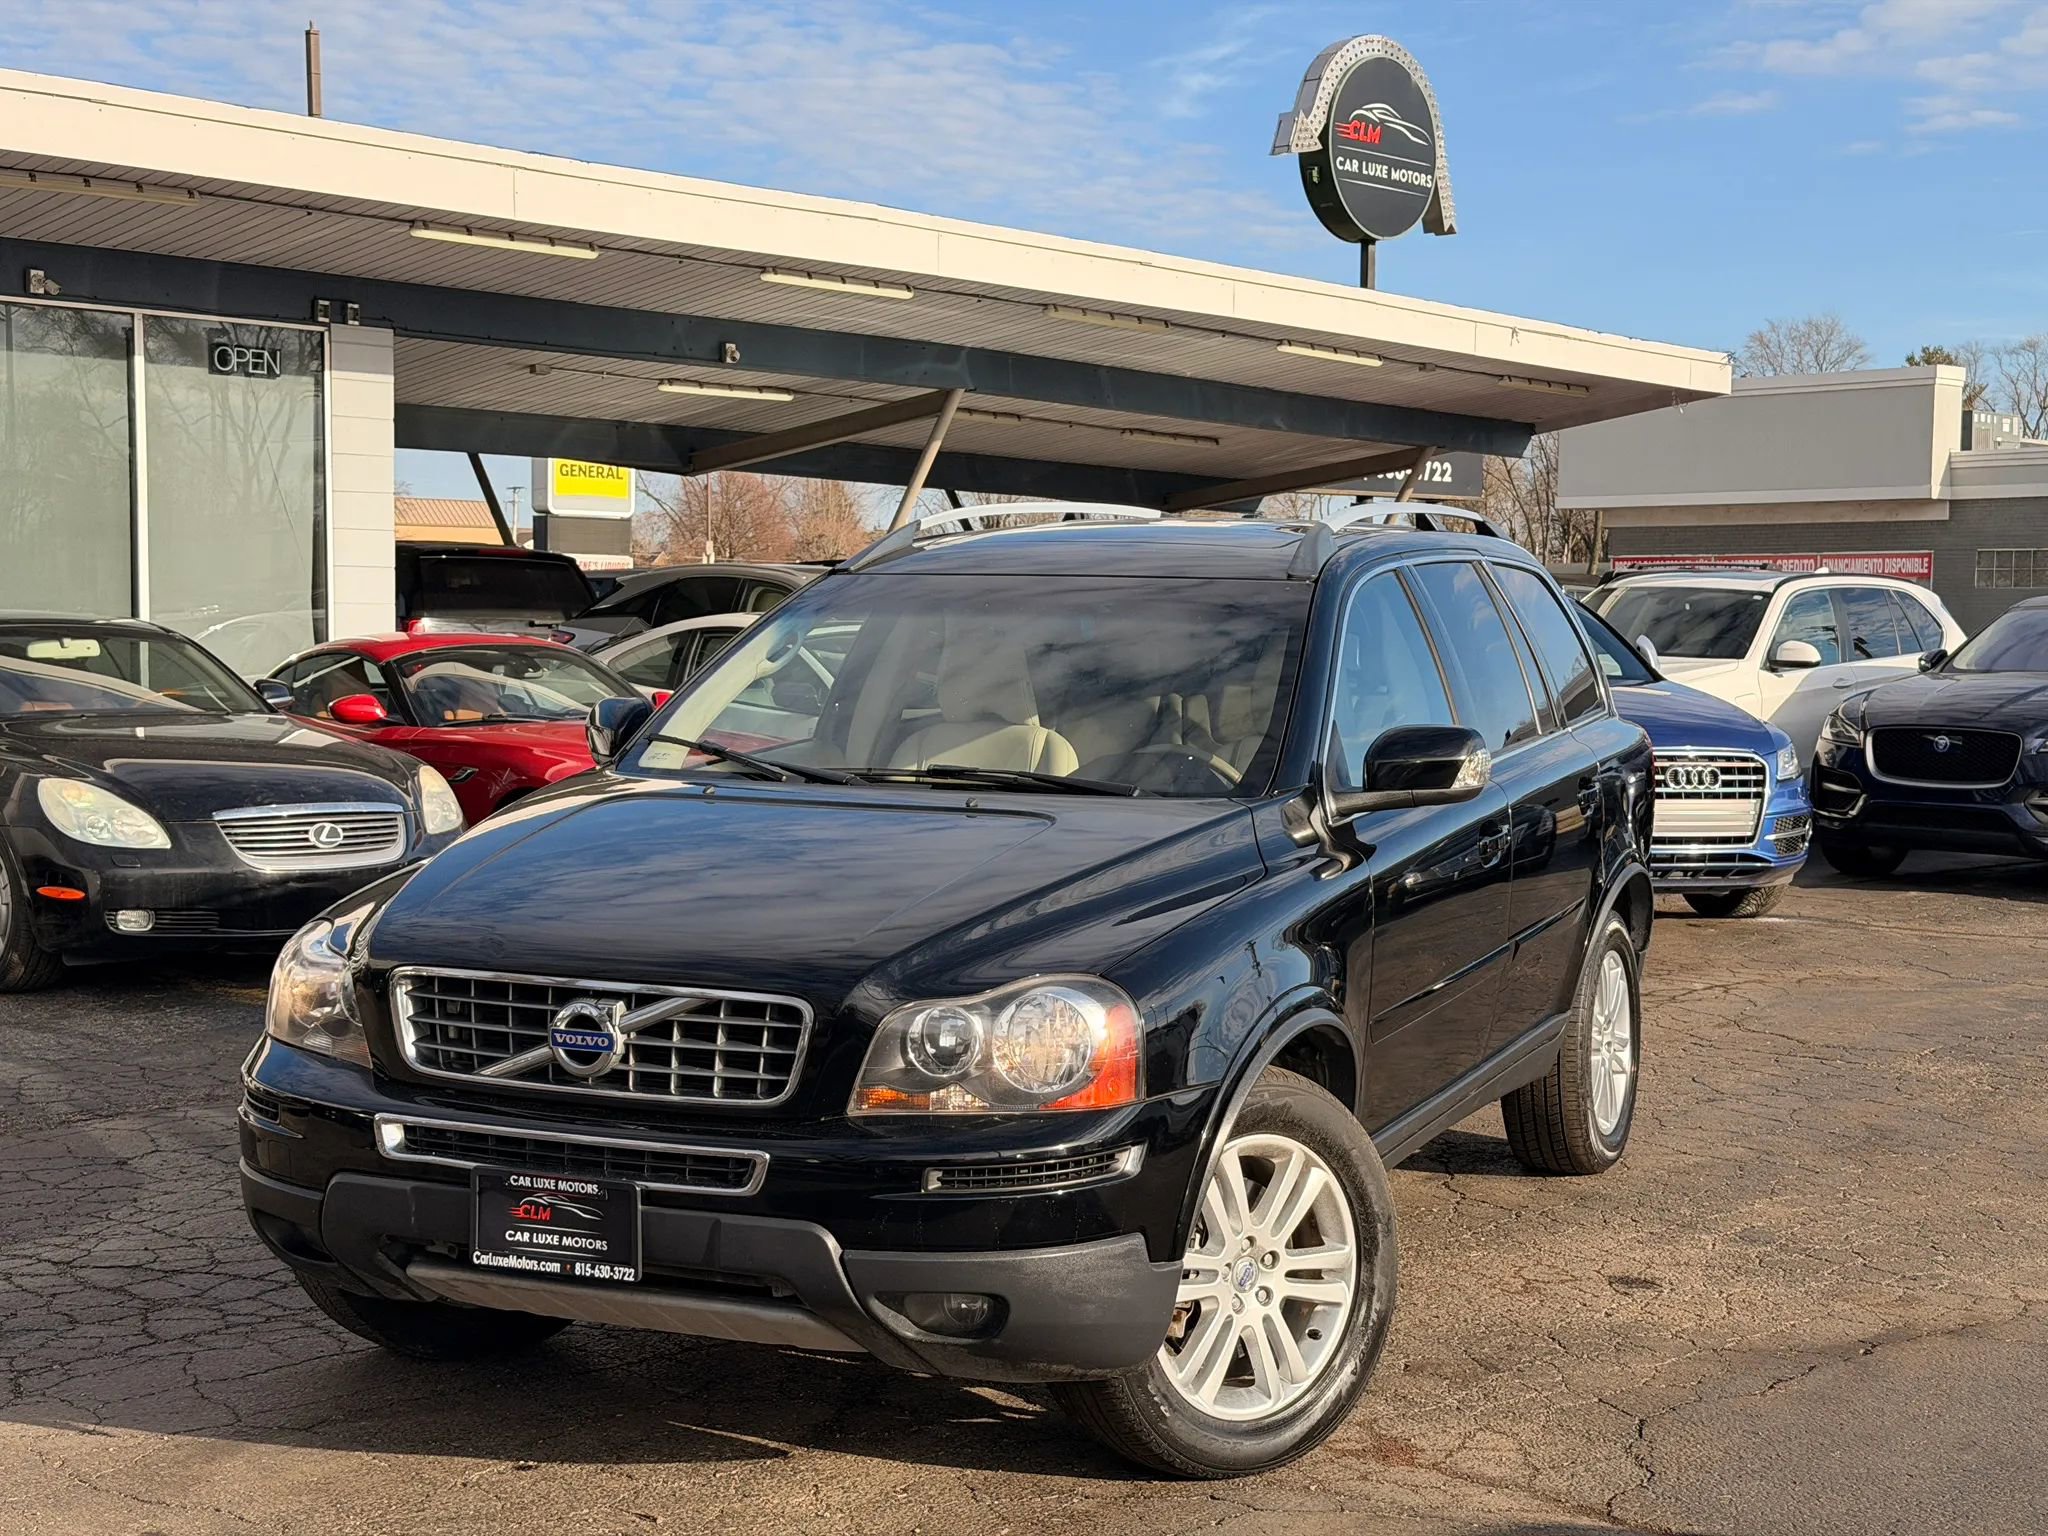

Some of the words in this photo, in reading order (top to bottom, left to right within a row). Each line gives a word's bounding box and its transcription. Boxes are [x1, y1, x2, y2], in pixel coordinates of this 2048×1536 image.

[1349, 120, 1381, 144] CLM
[1336, 156, 1359, 173] CAR
[1362, 161, 1388, 179] LUXE
[1391, 167, 1432, 188] MOTORS
[214, 346, 280, 375] OPEN
[560, 463, 624, 480] GENERAL
[1822, 558, 1883, 573] FINANCIAMIENTO
[1884, 557, 1929, 574] DISPONIBLE
[553, 1032, 609, 1047] VOLVO
[510, 1175, 531, 1187] CAR
[533, 1177, 556, 1190] LUXE
[558, 1181, 599, 1195] MOTORS
[520, 1204, 551, 1220] CLM
[505, 1230, 530, 1242] CAR
[532, 1232, 560, 1245] LUXE
[561, 1236, 608, 1251] MOTORS
[472, 1250, 561, 1273] CarLuxeMotors.com
[574, 1262, 635, 1281] 815-630-3722
